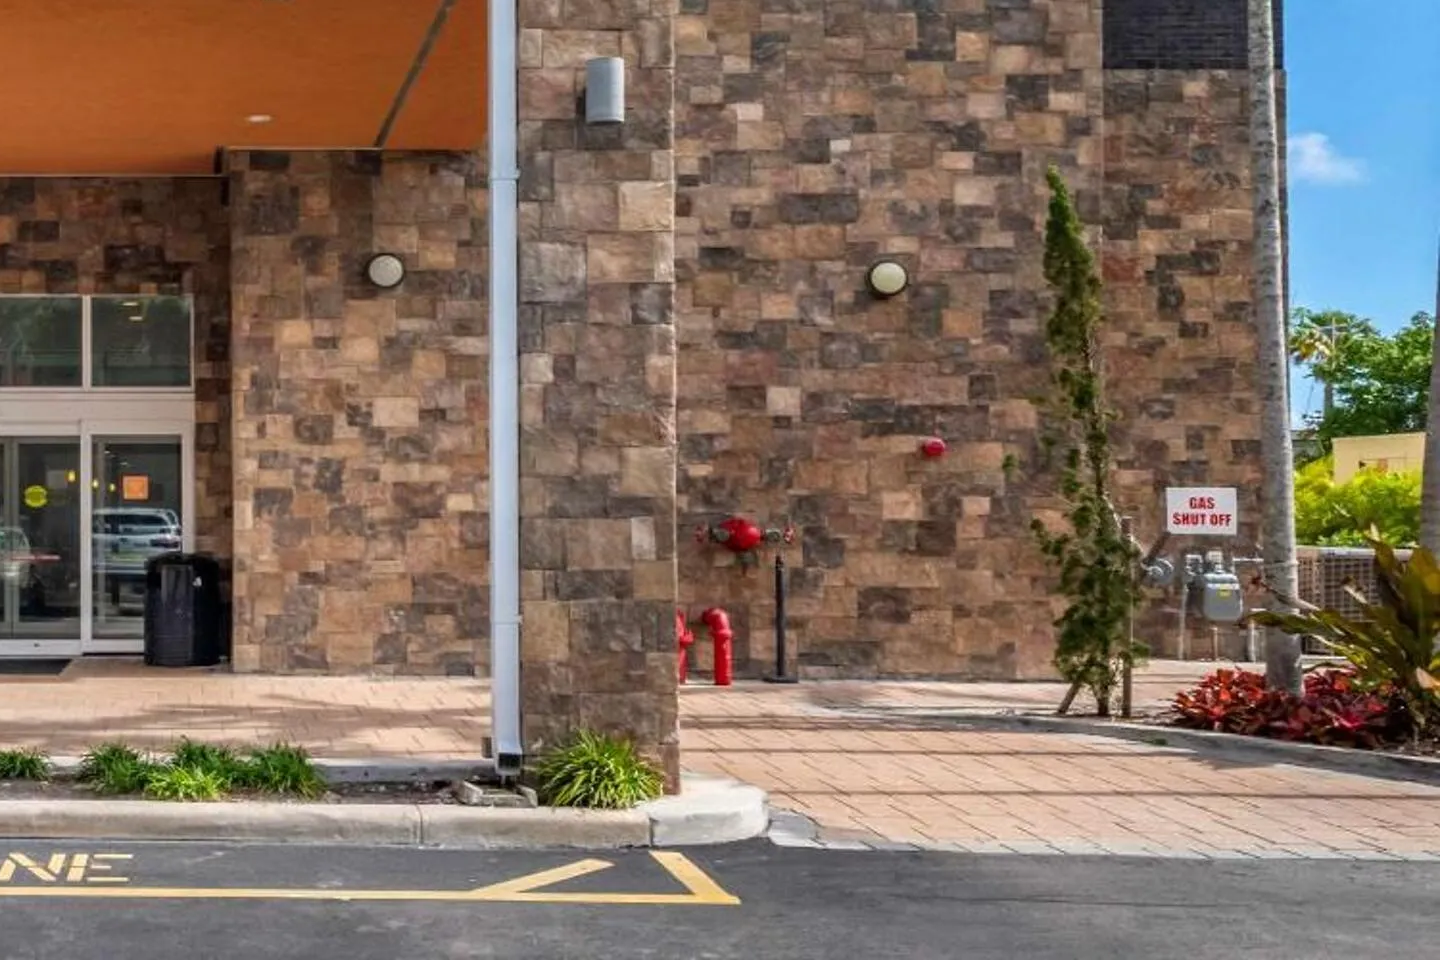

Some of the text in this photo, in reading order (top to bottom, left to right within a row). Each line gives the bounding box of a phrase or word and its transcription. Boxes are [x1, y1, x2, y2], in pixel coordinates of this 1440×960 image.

[1189, 496, 1216, 510] GAS
[1172, 512, 1232, 526] SHUT OFF
